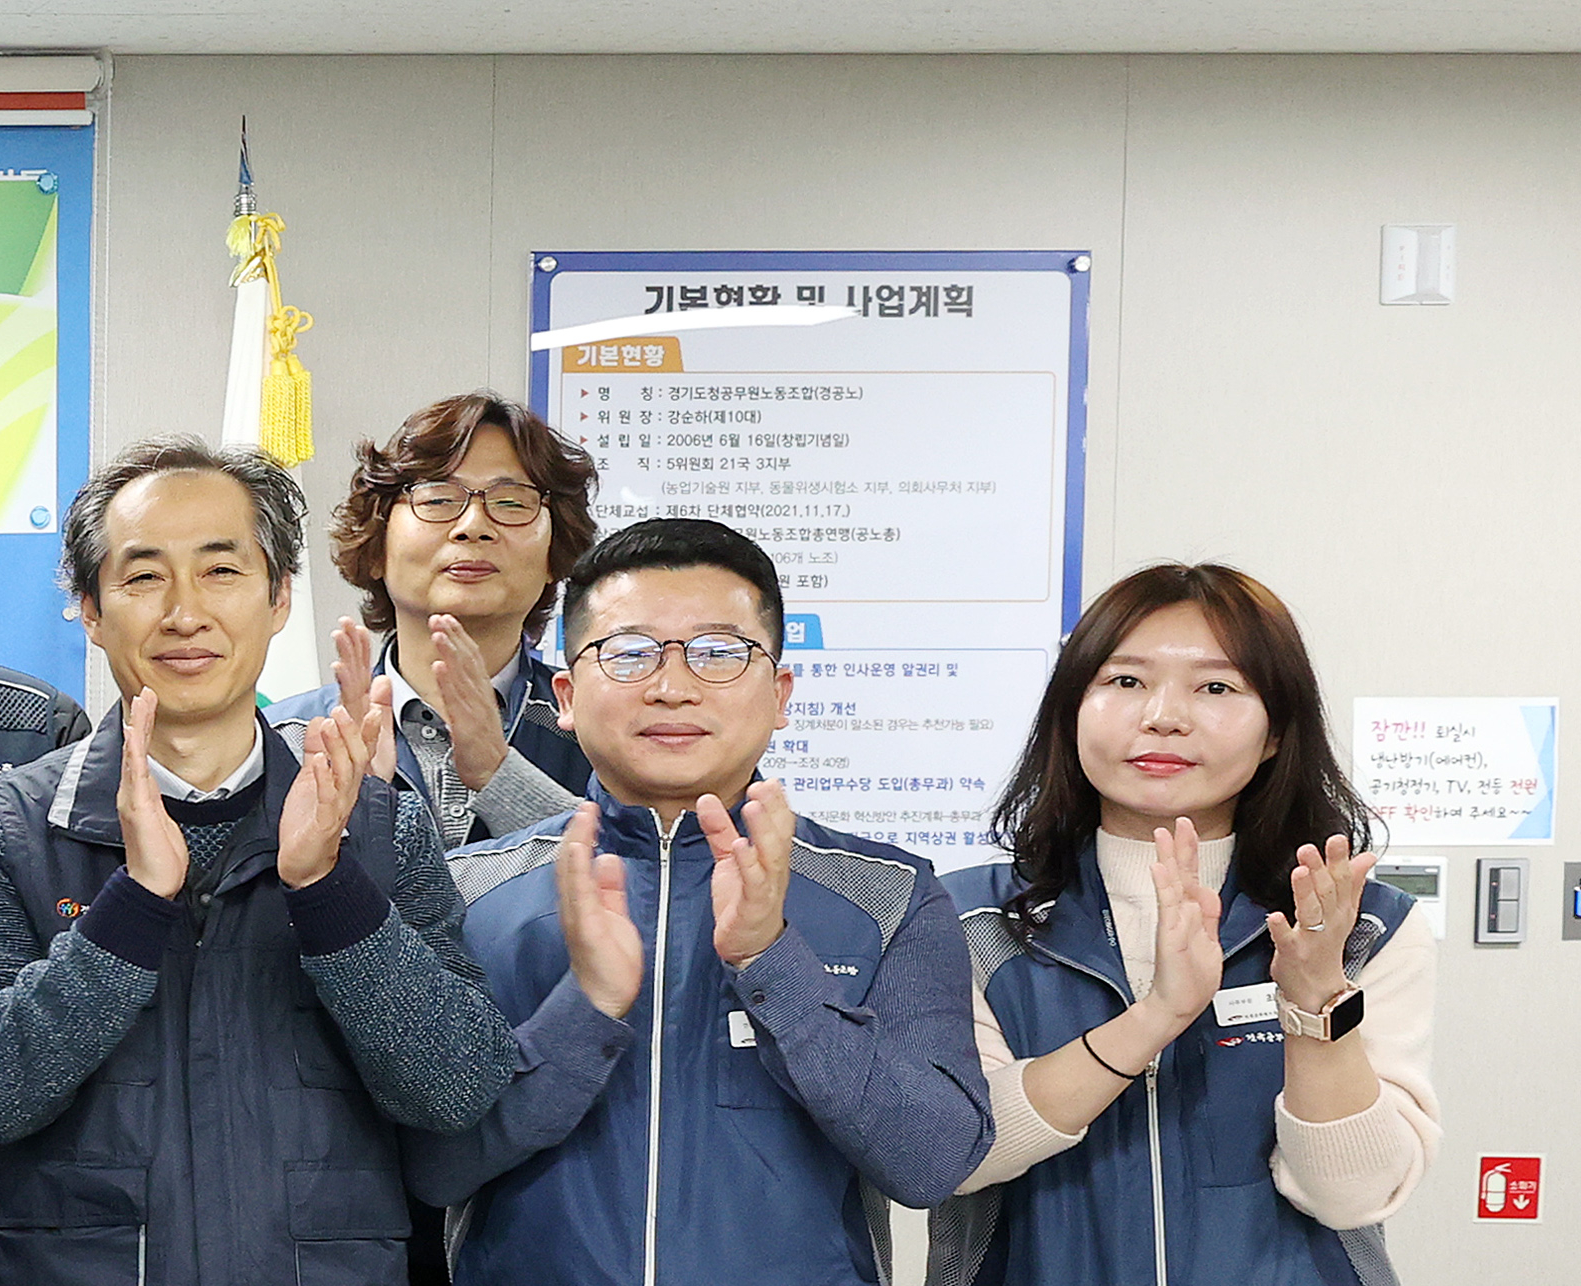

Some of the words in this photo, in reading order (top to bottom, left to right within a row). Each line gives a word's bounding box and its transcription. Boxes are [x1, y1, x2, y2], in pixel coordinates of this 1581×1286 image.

[577, 345, 665, 367] 기본현황
[669, 386, 863, 401] 경기도청공무원노동조합(경공노)
[668, 410, 761, 424] 강순하(제10대)
[667, 434, 713, 448] 2006년
[719, 433, 740, 447] 6월
[748, 434, 849, 448] 16일(창립기념일)
[667, 457, 713, 471] 5위원회
[720, 457, 750, 471] 21국
[756, 457, 791, 471] 3지부
[662, 481, 730, 495] (농업기술원
[770, 481, 858, 495] 동물위생시험소
[899, 481, 961, 494] 의회사무처
[967, 482, 996, 493] 지부)
[596, 504, 649, 518] 단체교섭
[666, 505, 701, 519] 제6차
[707, 503, 851, 519] 단체협약(2021.11.17.)
[808, 552, 838, 564] 노조)
[797, 575, 828, 588] 포함)
[811, 663, 837, 677] 통한
[843, 663, 895, 677] 인사운영
[902, 663, 939, 677] 알권리
[947, 663, 958, 677] 및
[831, 702, 856, 716] 개선
[1372, 720, 1425, 742] 잠깐!!
[1436, 723, 1475, 742] 퇴실시
[783, 740, 808, 753] 확대
[823, 757, 849, 769] 40명)
[794, 778, 871, 791] 관리업무수당
[878, 777, 953, 791] 도입(총무과)
[960, 777, 985, 791] 약속
[1370, 779, 1439, 796] 공기청정기,
[1447, 780, 1471, 794] TV,
[1478, 778, 1502, 795] 전등
[1510, 778, 1538, 796] 전원
[1404, 804, 1462, 822] 확인하여
[906, 832, 956, 845] 지역상권
